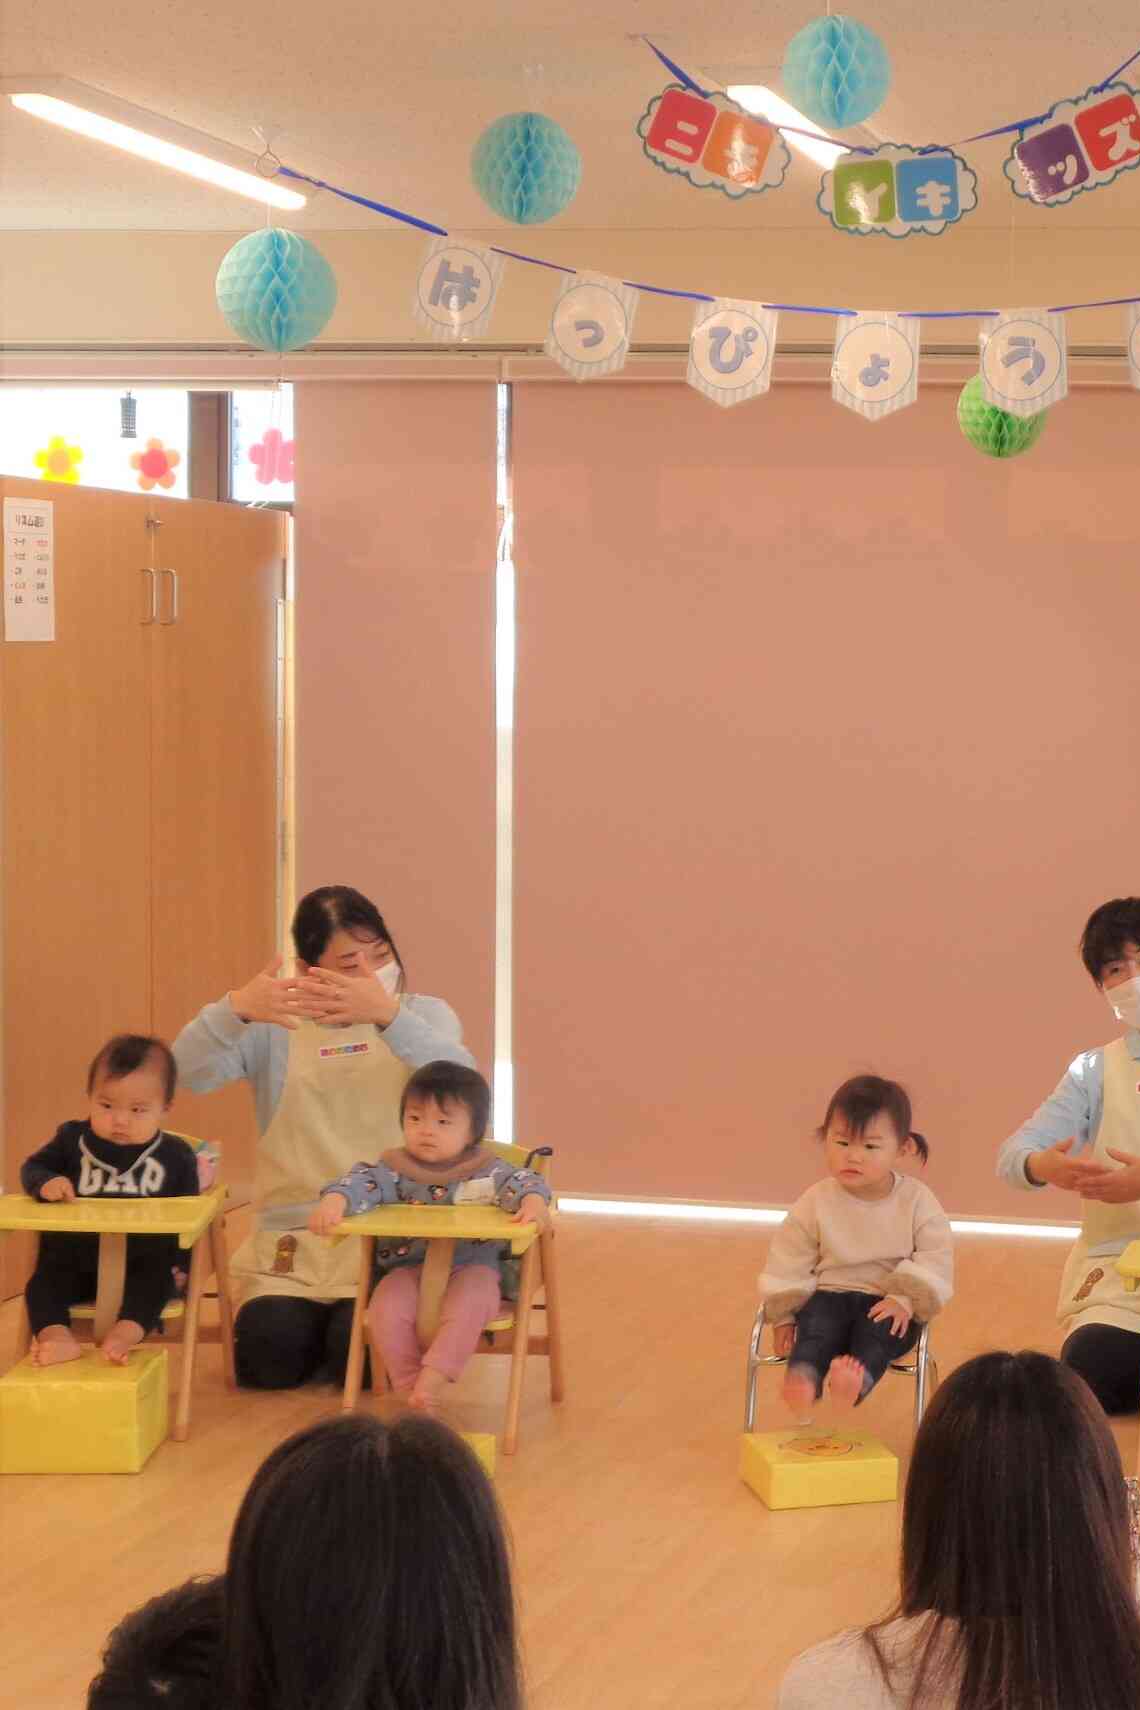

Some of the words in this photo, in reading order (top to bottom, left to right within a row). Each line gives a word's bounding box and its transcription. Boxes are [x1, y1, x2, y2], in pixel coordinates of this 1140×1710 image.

[428, 259, 481, 312] は
[708, 325, 759, 375] ぴ
[1000, 335, 1047, 386] う
